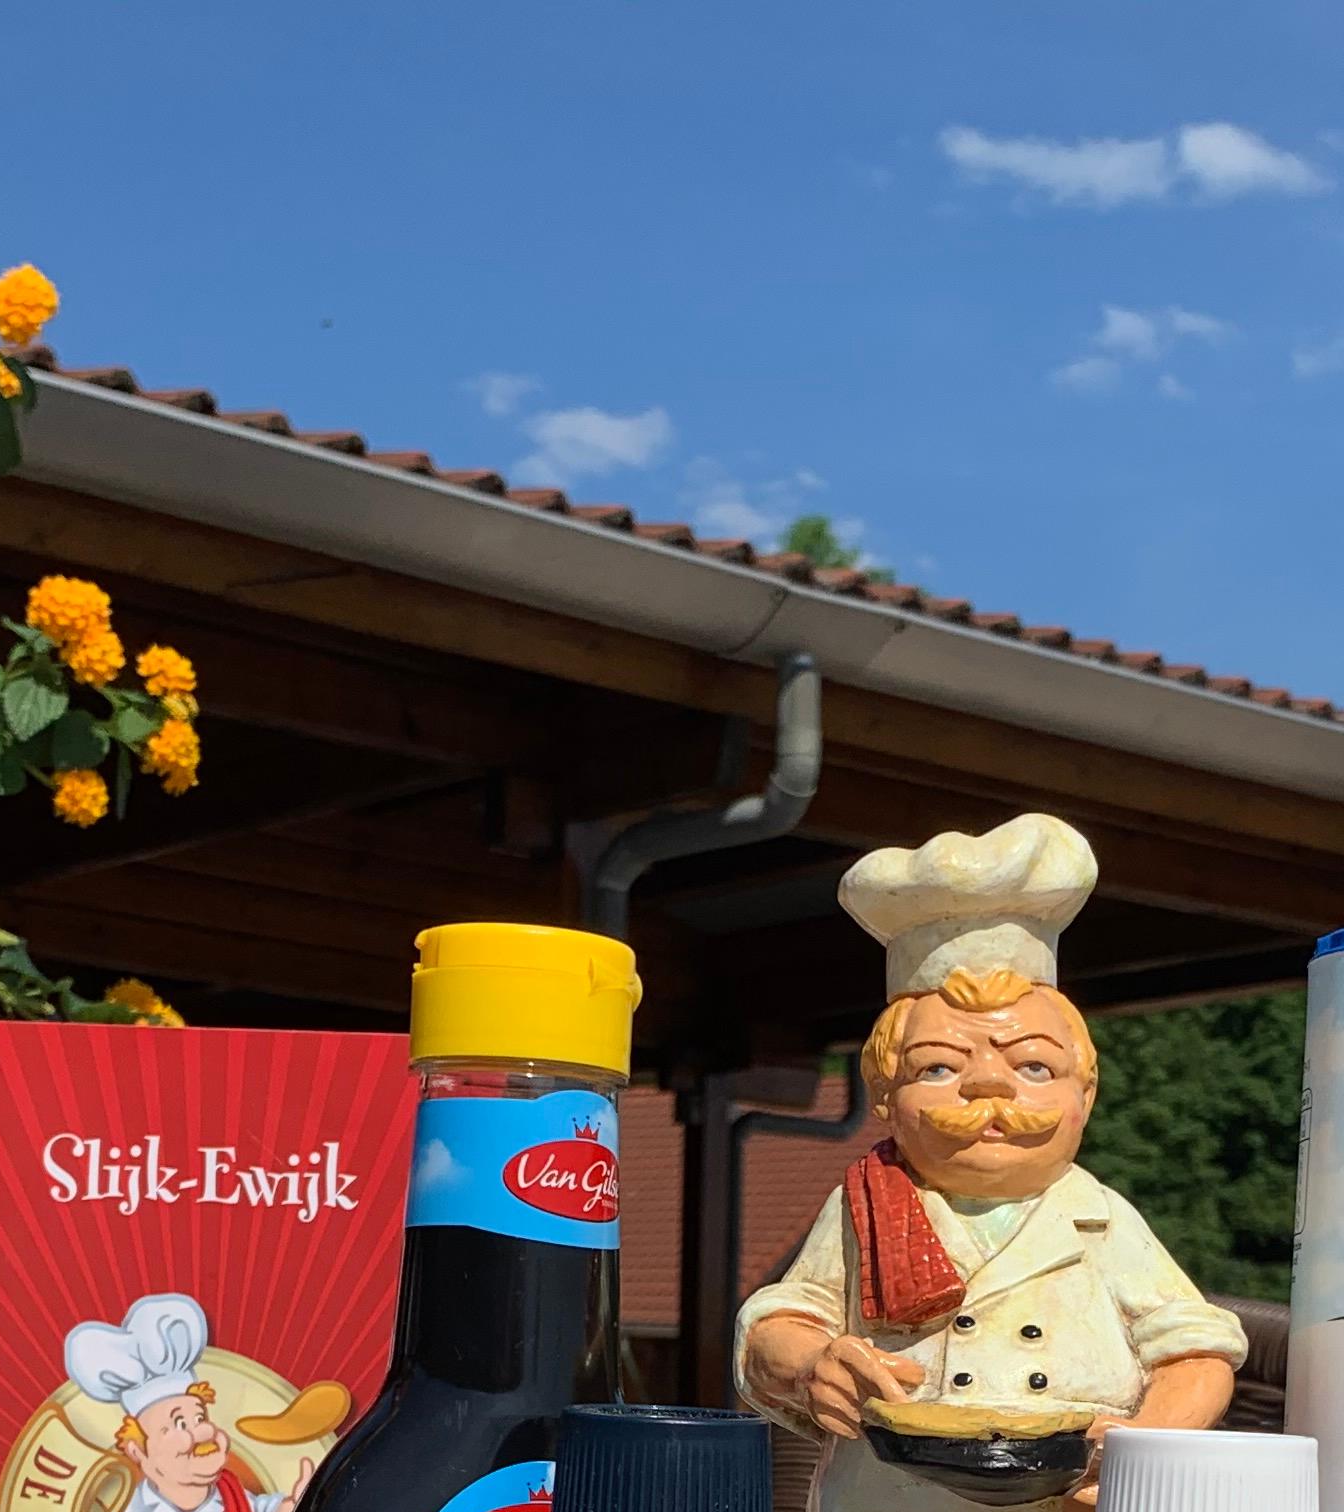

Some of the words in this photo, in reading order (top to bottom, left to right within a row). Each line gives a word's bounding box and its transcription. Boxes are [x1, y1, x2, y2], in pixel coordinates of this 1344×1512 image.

[43, 1132, 359, 1223] Slijk-Ewijk
[517, 1153, 578, 1191] Van
[20, 1446, 77, 1505] DE
